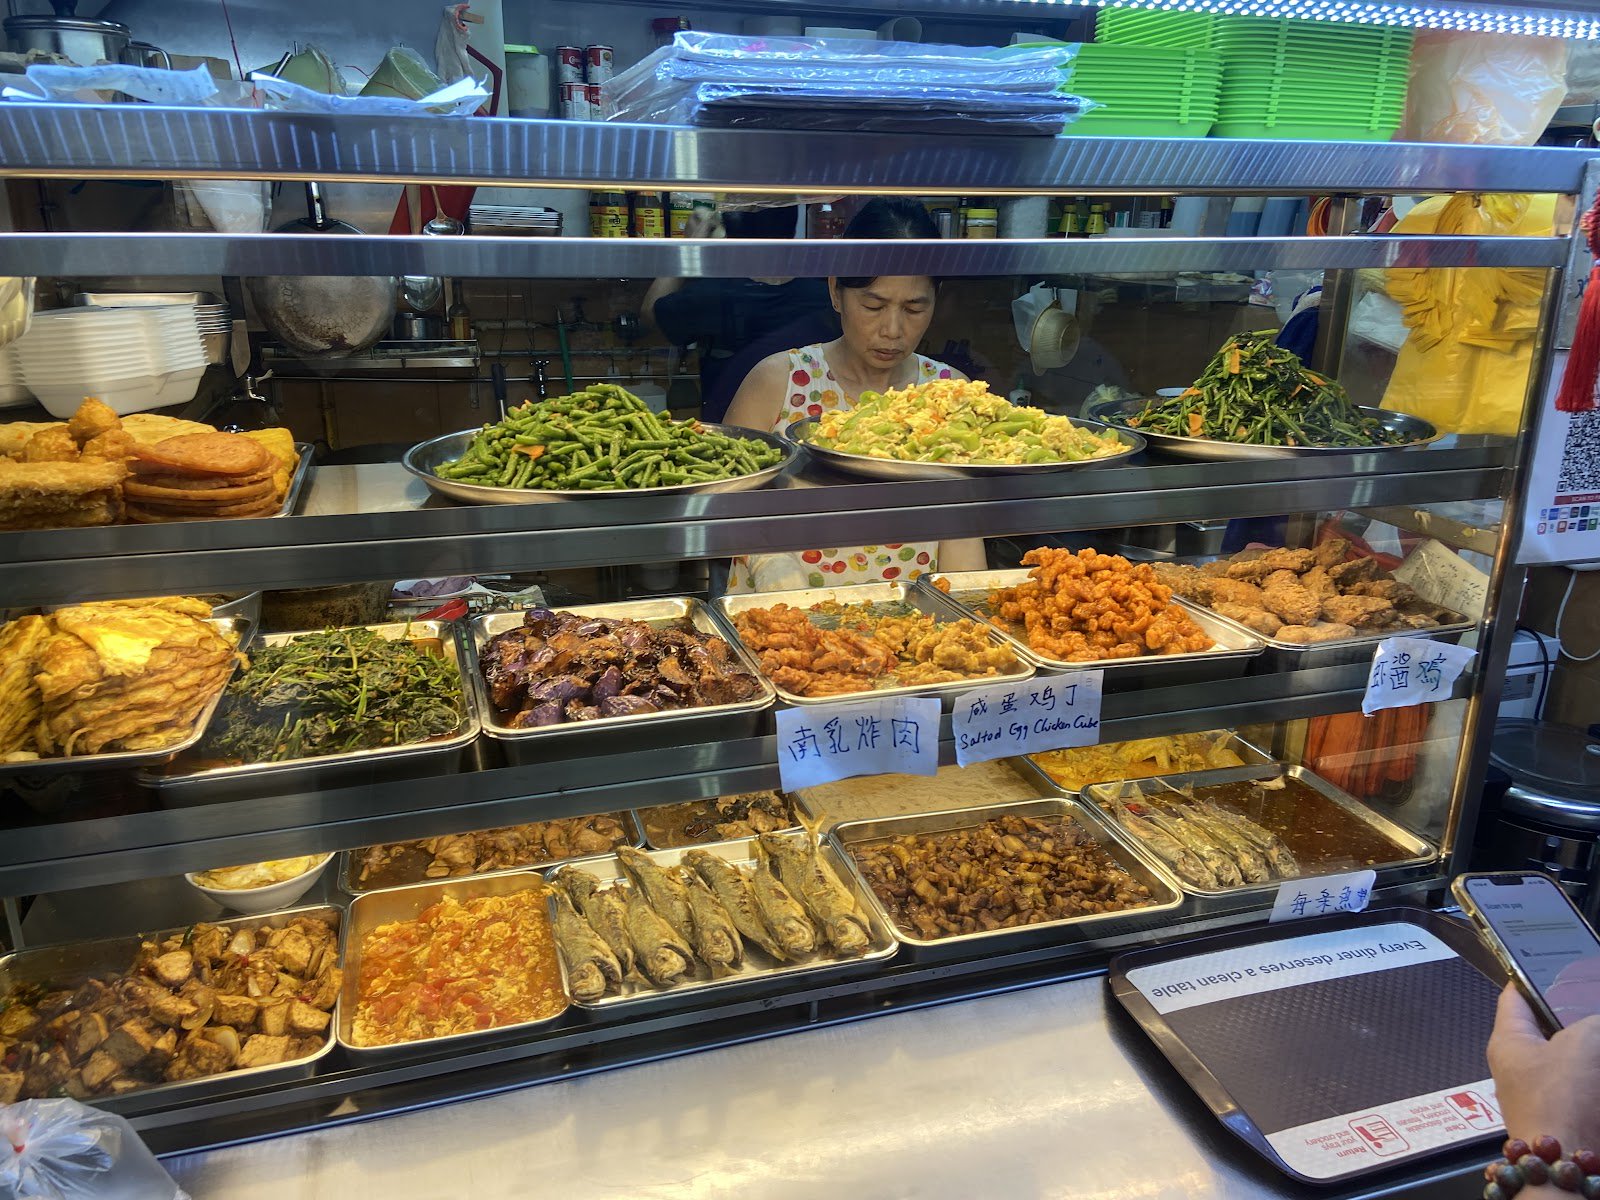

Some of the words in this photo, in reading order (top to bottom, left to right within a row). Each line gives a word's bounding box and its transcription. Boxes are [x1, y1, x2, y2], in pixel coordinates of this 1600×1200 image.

[1009, 722, 1029, 741] Egg
[1033, 717, 1071, 734] Chicken
[1073, 714, 1099, 729] Cube
[787, 715, 920, 762] 南乳炸肉
[1336, 947, 1377, 963] diner
[1379, 939, 1427, 955] Every
[1244, 968, 1257, 978] a
[1258, 954, 1334, 977] deserves
[1196, 970, 1243, 989] clean
[1151, 981, 1196, 999] table
[1304, 1133, 1336, 1147] crockery
[1335, 1130, 1352, 1140] and
[1339, 1136, 1357, 1148] your
[1321, 1140, 1341, 1151] trays
[1336, 1145, 1367, 1158] Return
